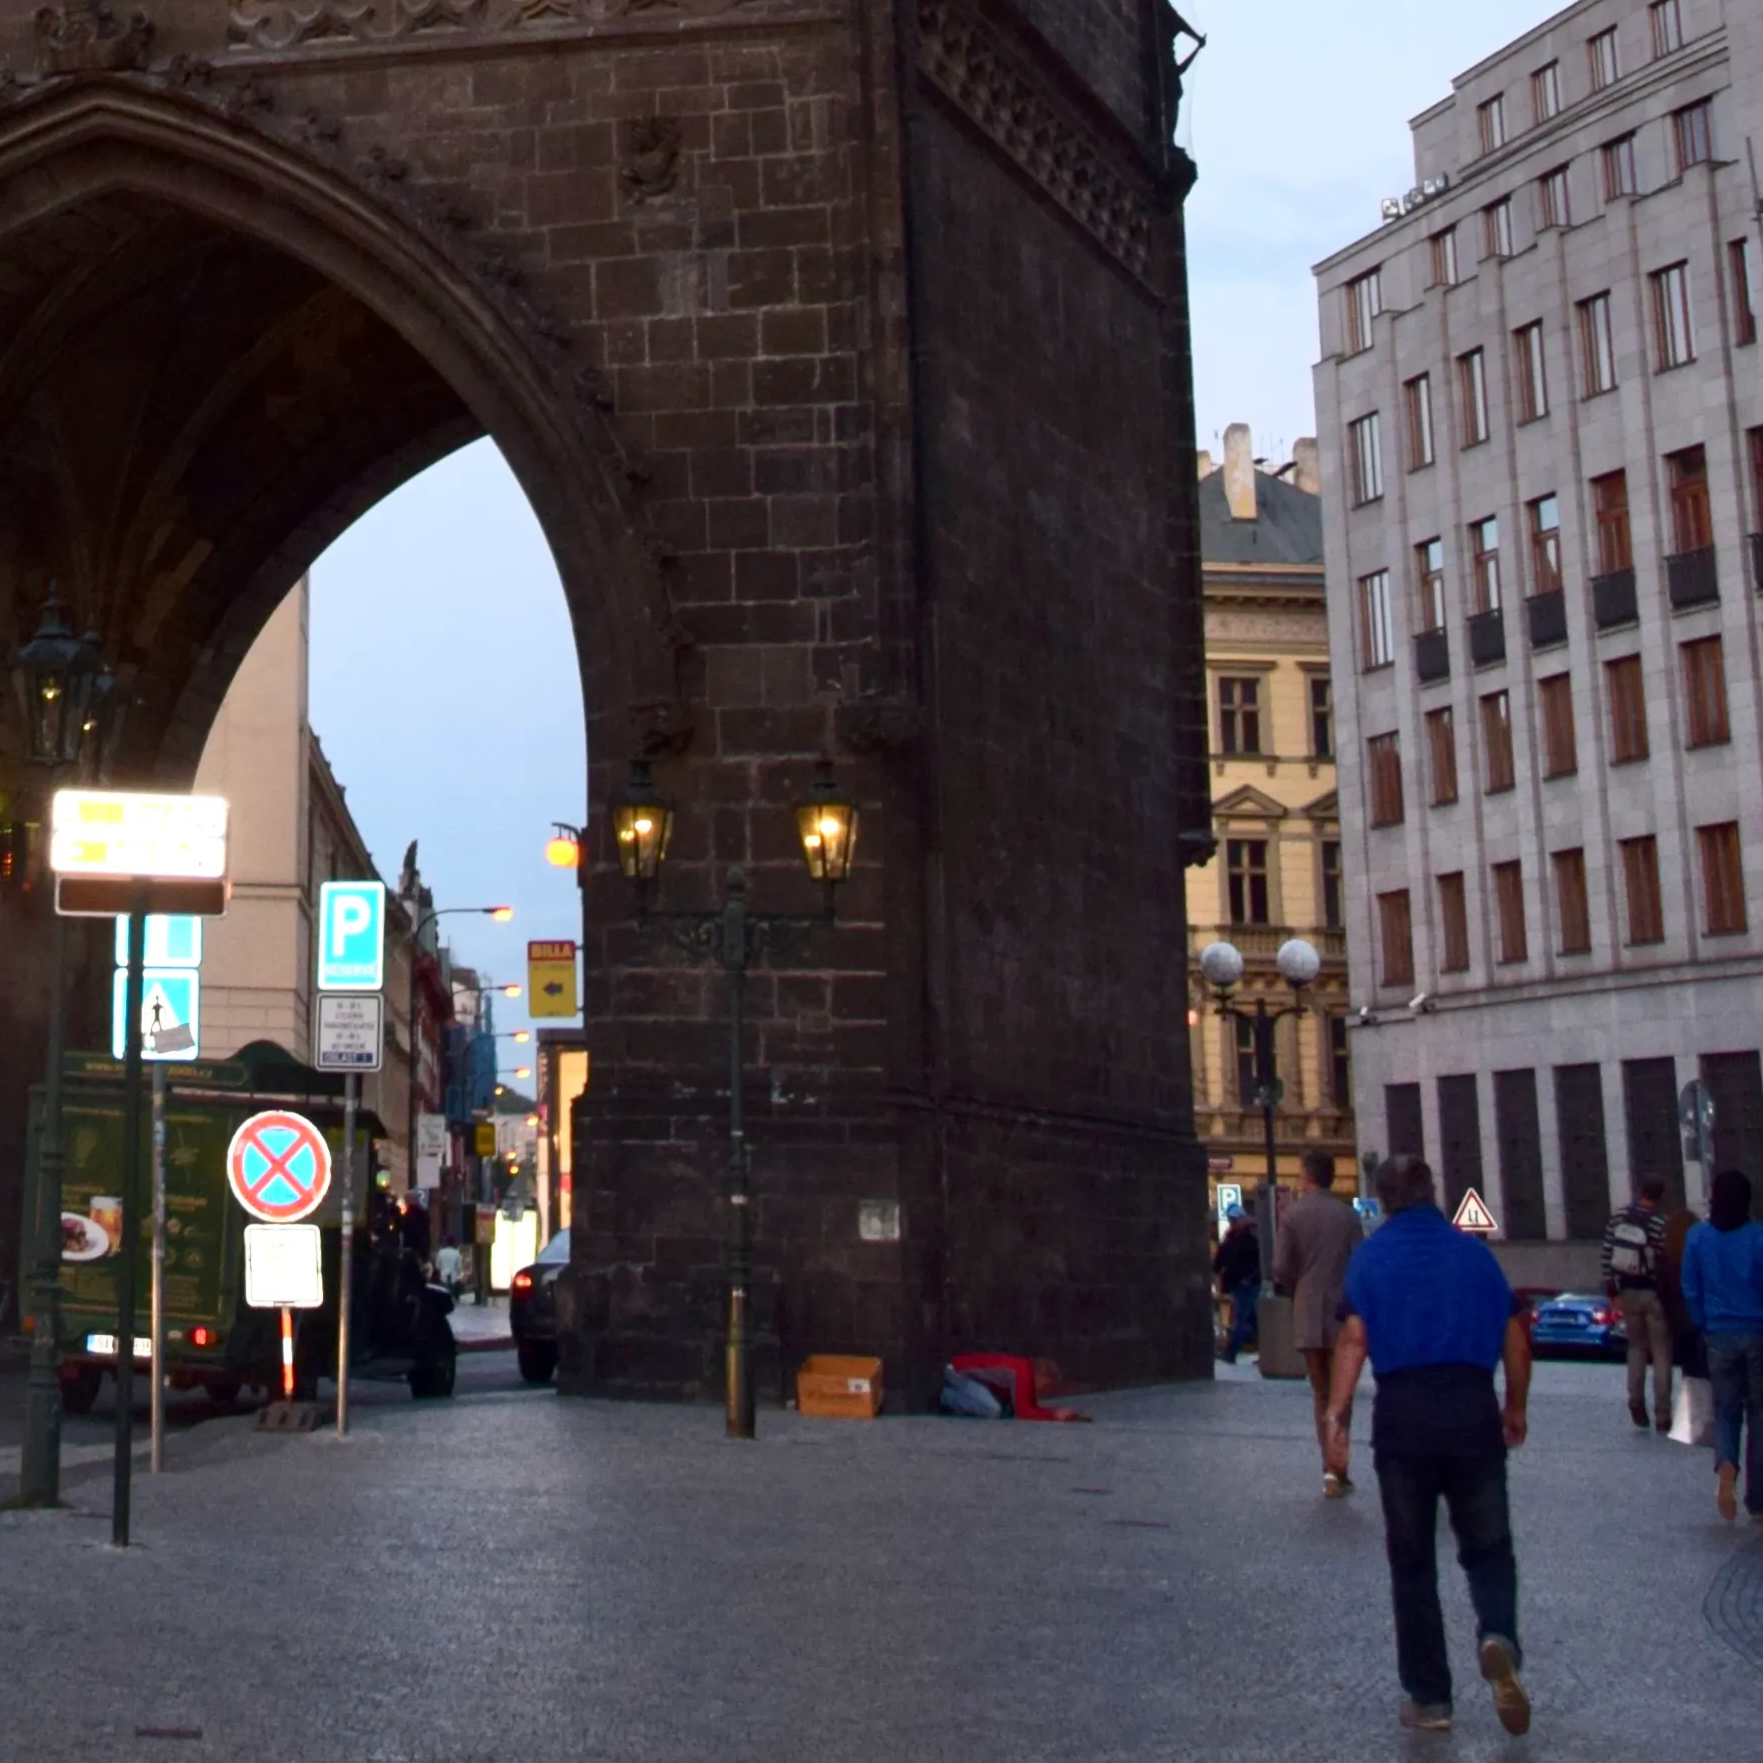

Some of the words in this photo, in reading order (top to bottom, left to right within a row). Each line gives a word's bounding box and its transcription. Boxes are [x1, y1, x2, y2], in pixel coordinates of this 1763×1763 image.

[332, 895, 371, 957] P
[531, 943, 572, 958] BILLA
[1222, 1189, 1237, 1209] P
